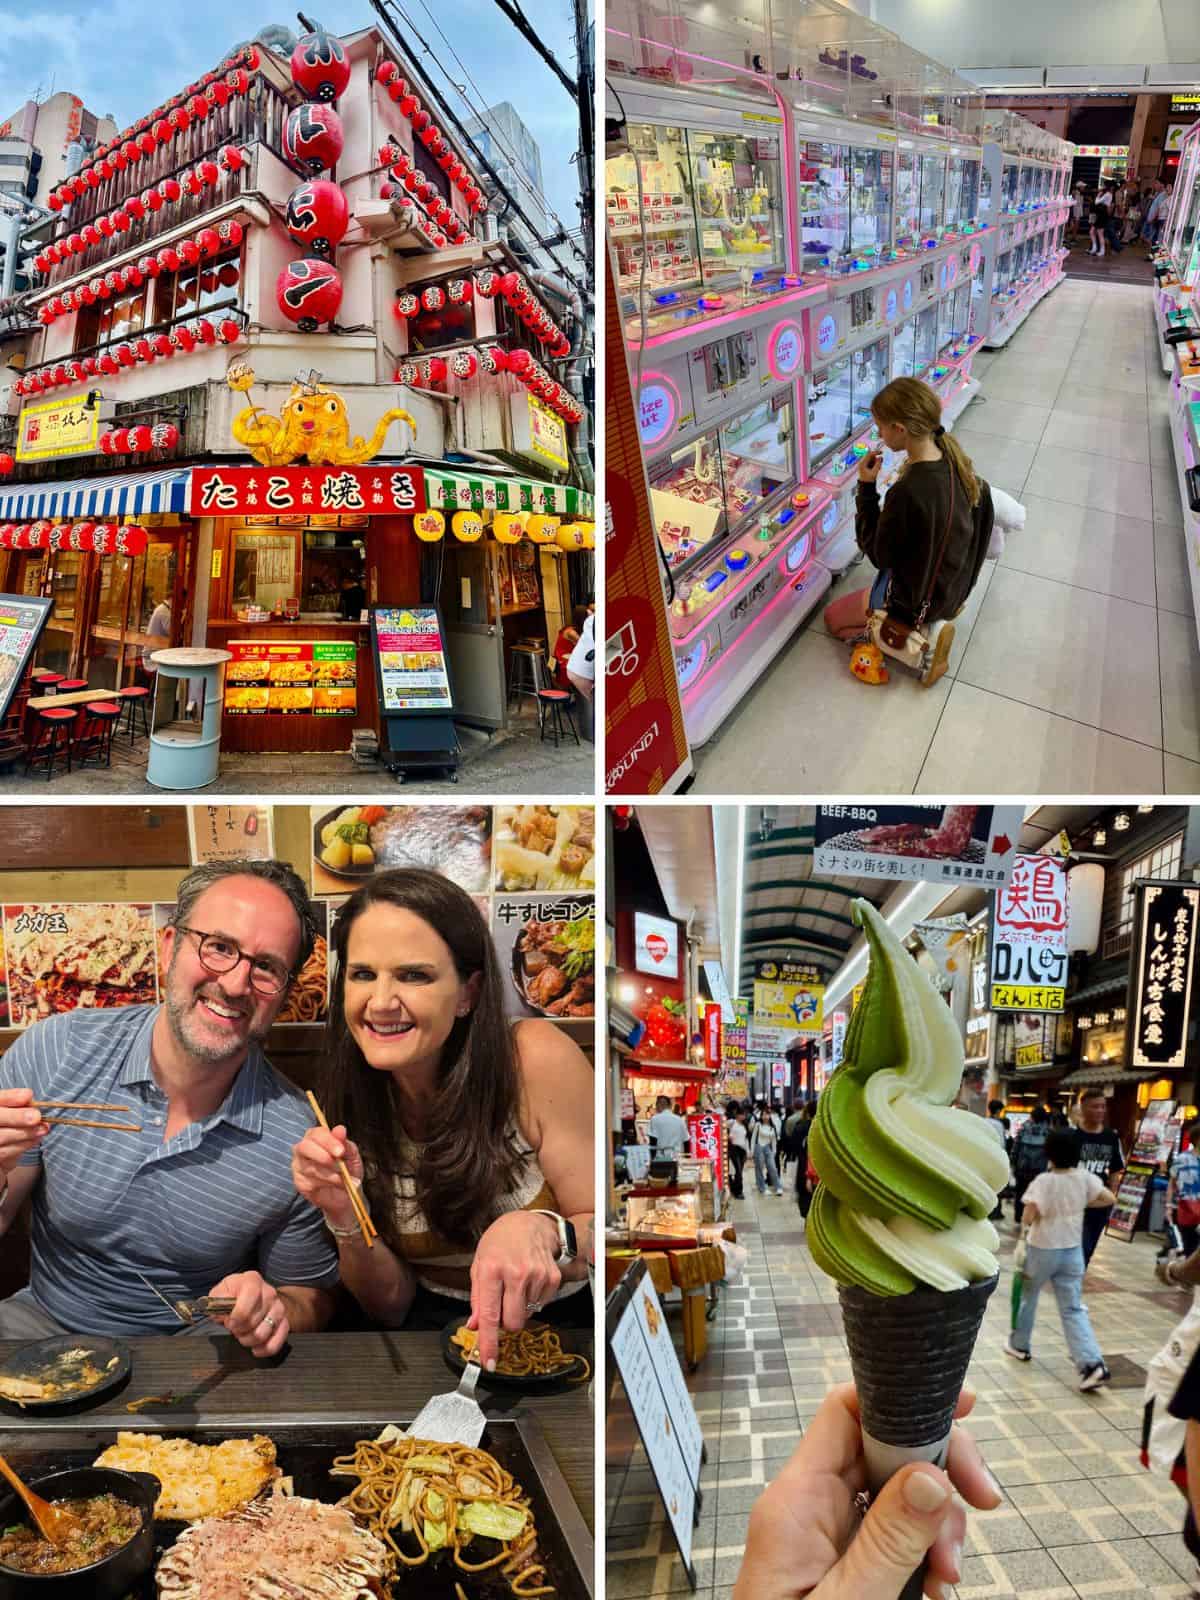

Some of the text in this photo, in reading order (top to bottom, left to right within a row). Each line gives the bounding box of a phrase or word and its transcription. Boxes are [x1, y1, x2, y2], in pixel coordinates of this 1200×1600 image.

[201, 472, 416, 510] たこ焼き
[301, 477, 313, 505] 大阪
[371, 477, 384, 504] 名物
[821, 805, 878, 823] BEEF-BBQ
[14, 912, 69, 934] メガ玉
[1143, 922, 1170, 1045] しんぱち食堂
[994, 987, 1062, 1009] なんば店
